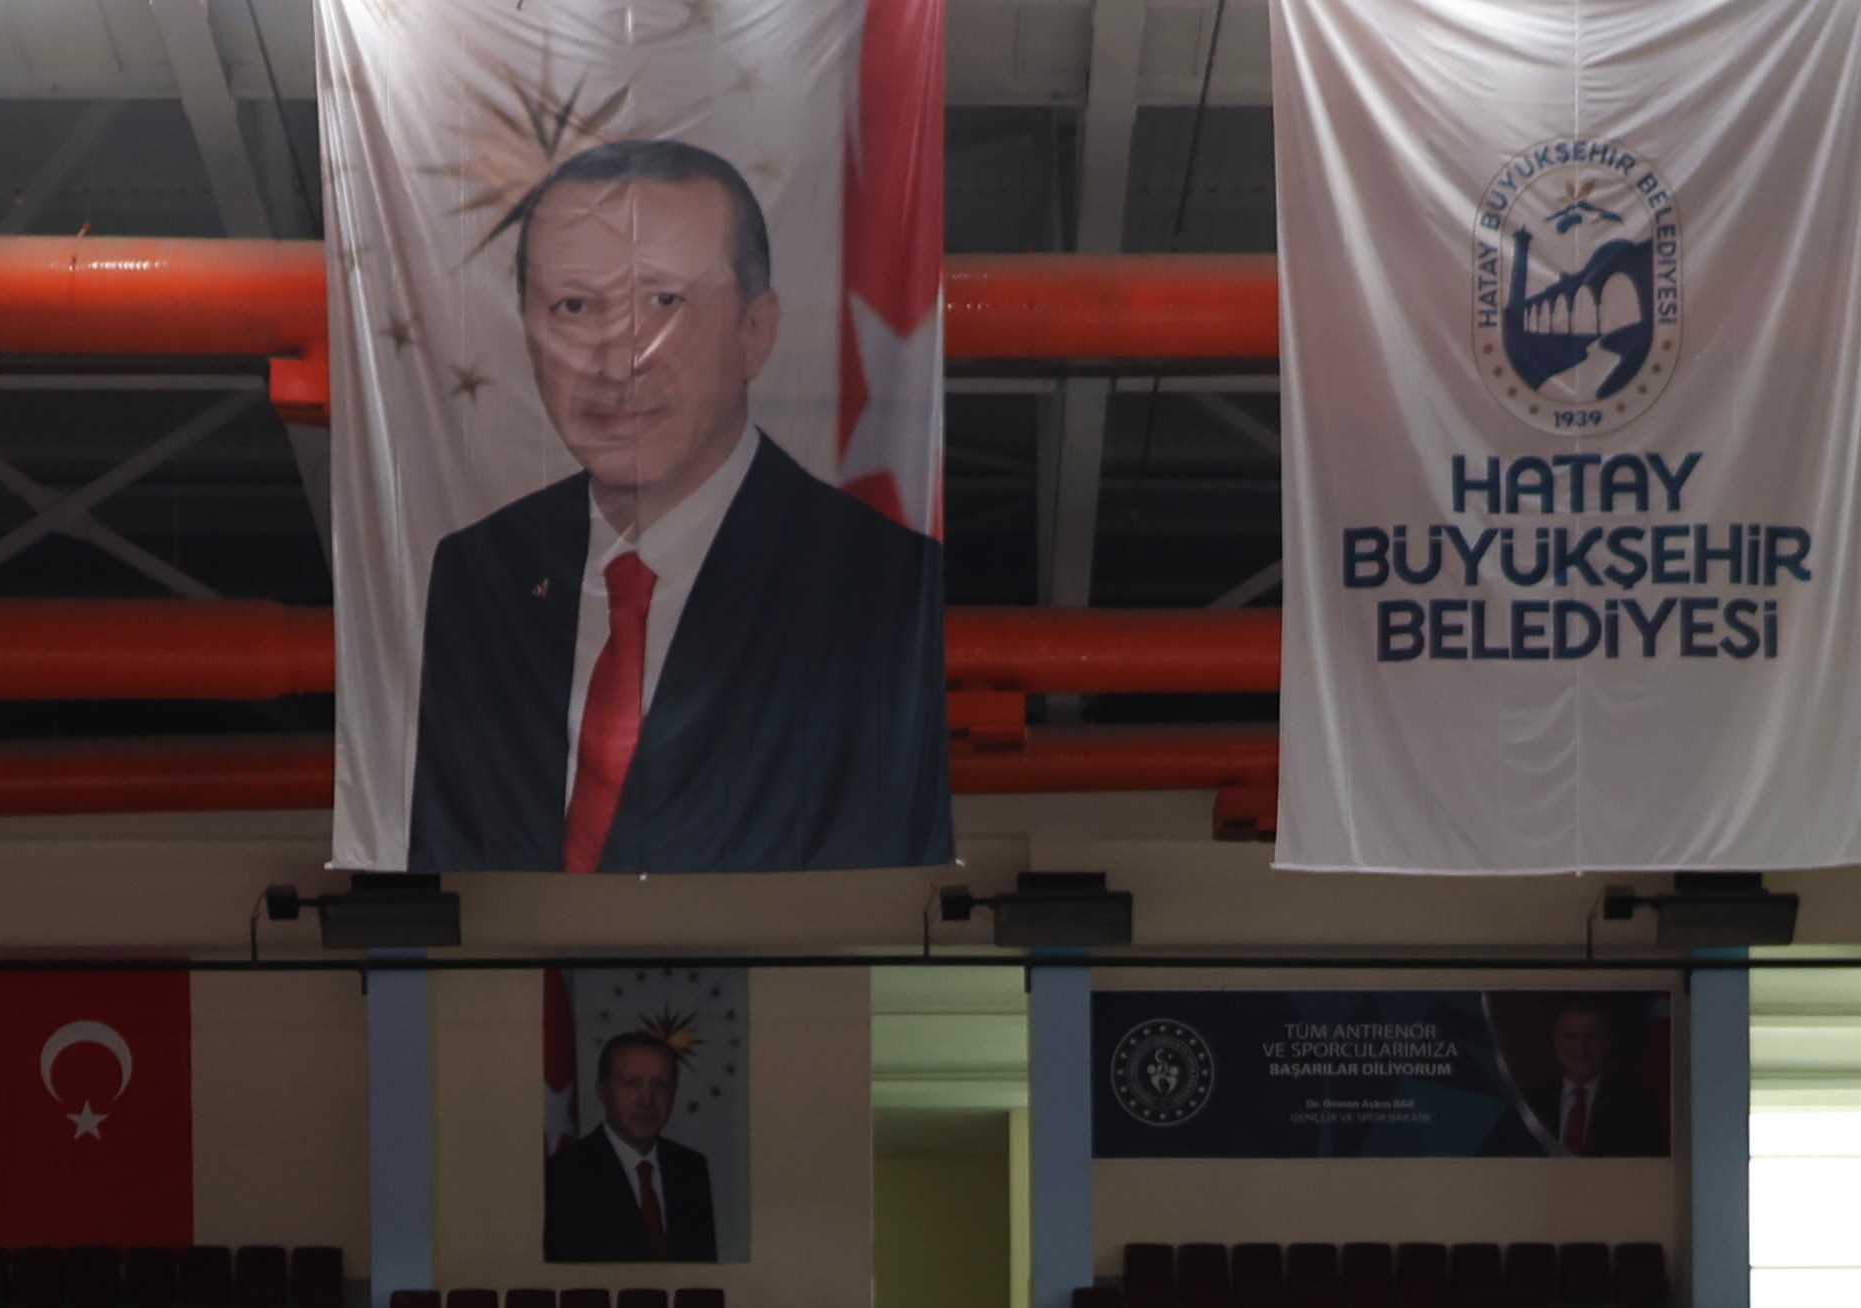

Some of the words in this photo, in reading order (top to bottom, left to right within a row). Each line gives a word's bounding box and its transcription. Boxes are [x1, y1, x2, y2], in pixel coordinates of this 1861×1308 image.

[1477, 240, 1498, 328] HATAY
[1553, 410, 1603, 429] 1939
[1451, 452, 1703, 515] HATAY
[1342, 523, 1812, 590] BÜYÜKŞEHİR
[1377, 597, 1778, 662] BELEDİYESİ
[1262, 1042, 1285, 1058] VE
[1291, 1042, 1459, 1059] SPORCULARIMIZA
[1269, 1062, 1358, 1078] BAŞARILAR
[1362, 1060, 1452, 1077] DİLİYORUM
